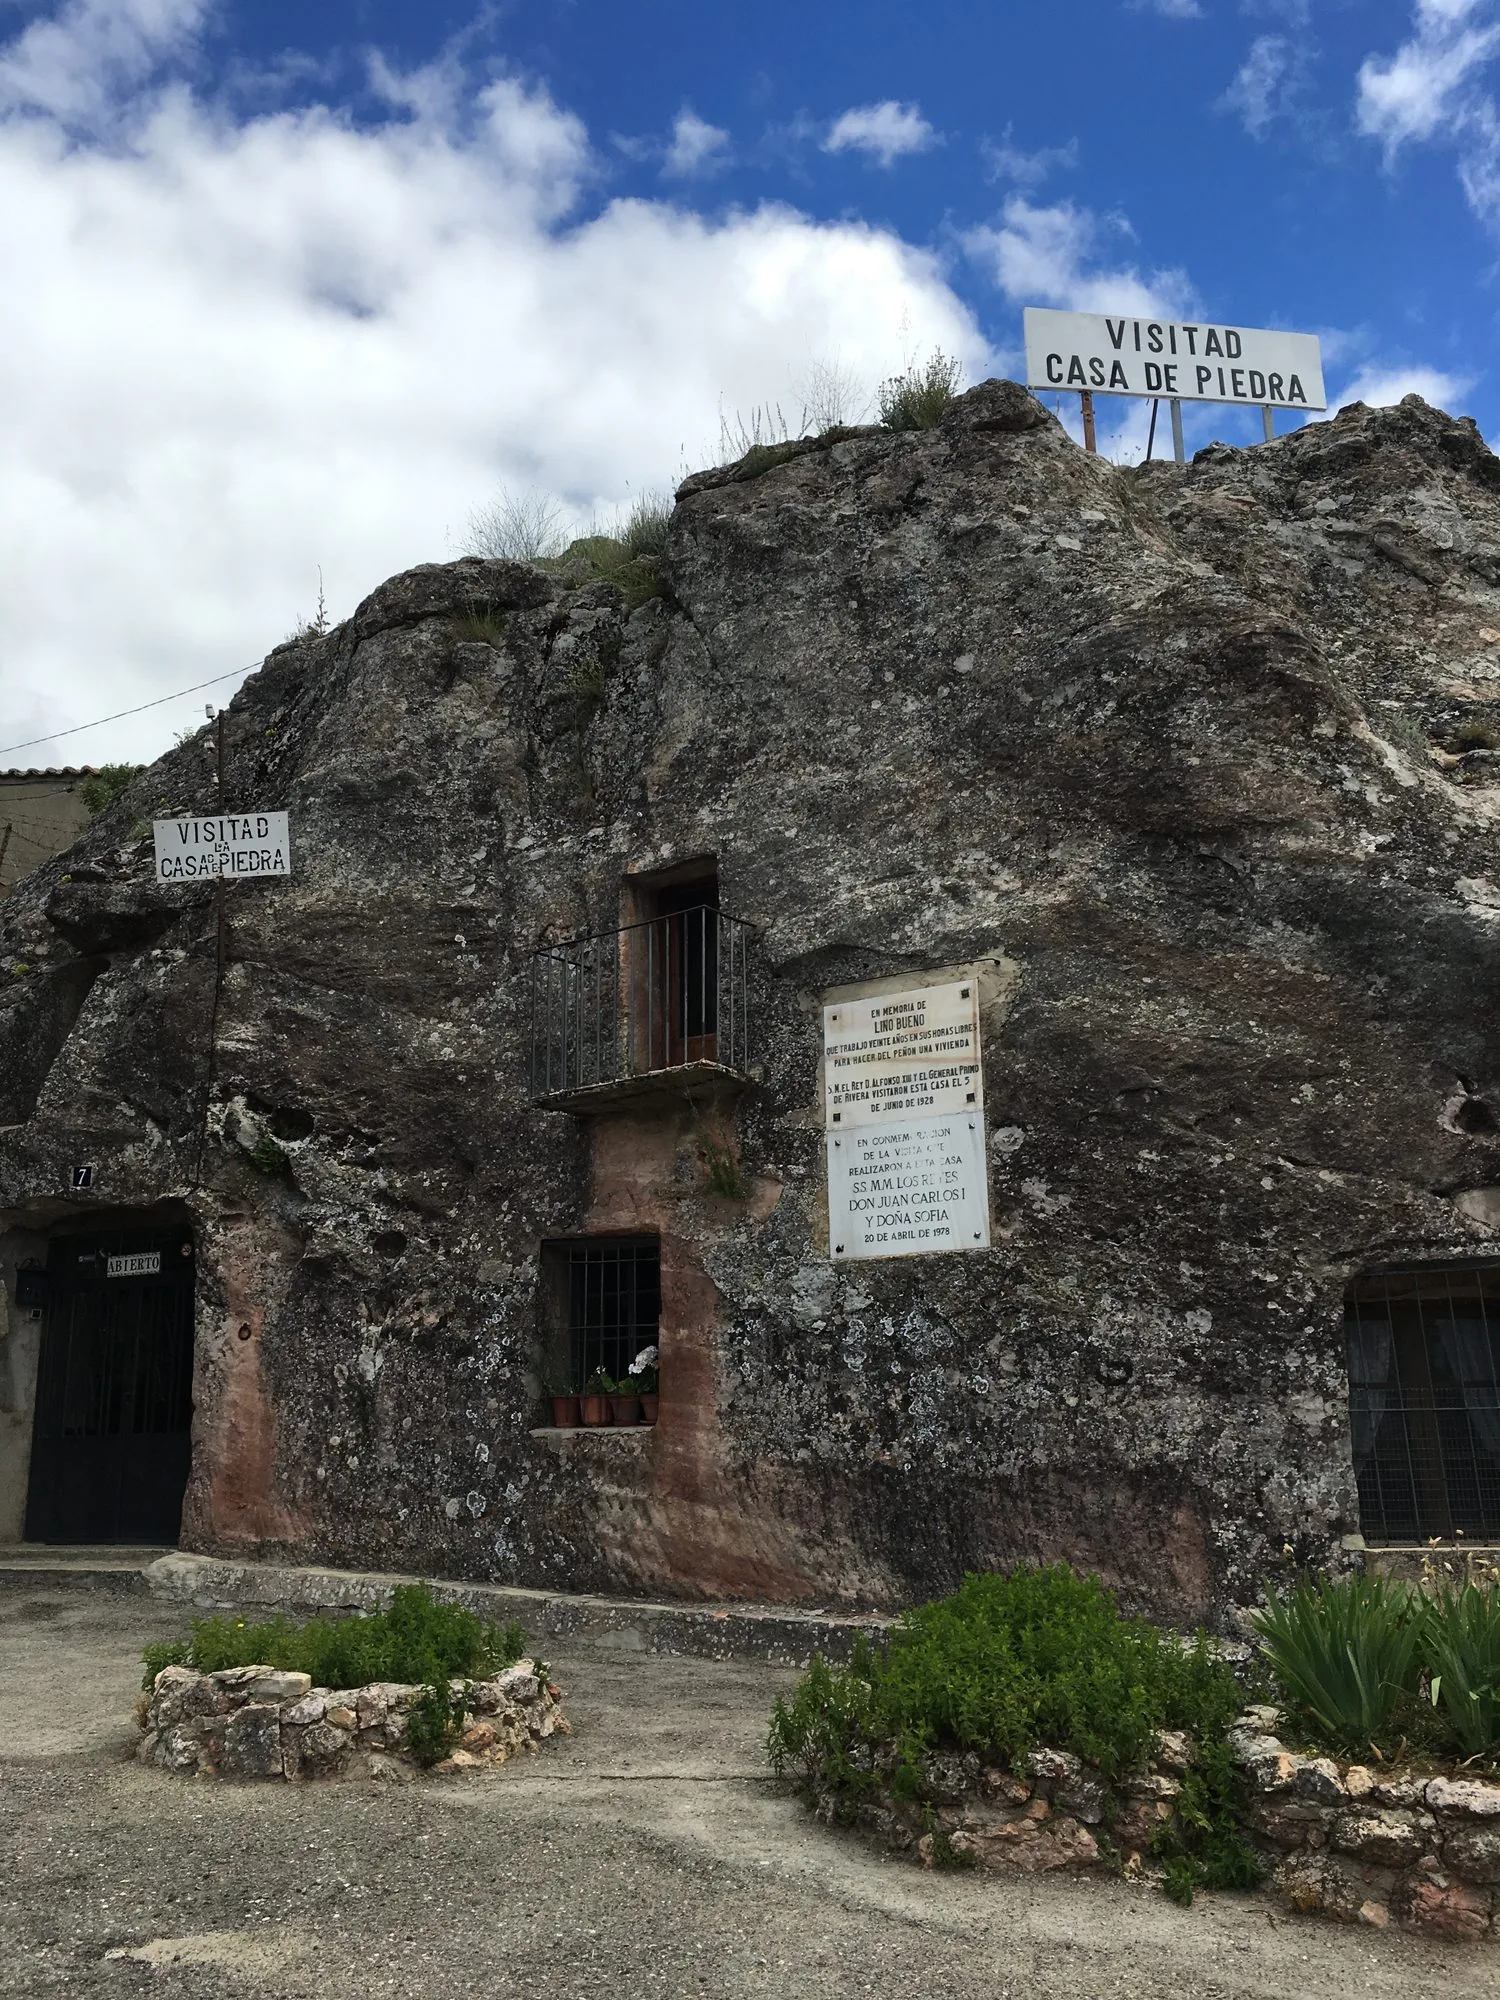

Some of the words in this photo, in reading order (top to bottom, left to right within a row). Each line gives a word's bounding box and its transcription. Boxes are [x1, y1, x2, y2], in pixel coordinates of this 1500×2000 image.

[1105, 319, 1242, 359] VISITAD
[1046, 353, 1129, 390] CASA
[1144, 362, 1178, 393] DE
[1196, 365, 1308, 403] PIEDRA
[177, 817, 268, 845] VISITAD
[214, 841, 230, 853] LA
[161, 855, 209, 877] CASA
[219, 849, 284, 872] PIEDRA
[871, 1008, 881, 1018] EN
[883, 1003, 914, 1016] MEMORIA
[917, 1000, 926, 1011] DE
[874, 1018, 894, 1034] LINO
[896, 1013, 925, 1030] BUENO
[826, 1045, 839, 1056] QUE
[840, 1041, 868, 1054] TRABAJO
[869, 1036, 891, 1049] VEINTE
[892, 1033, 908, 1045] AÑOS
[909, 1032, 919, 1042] EN
[919, 1030, 932, 1041] SUS
[932, 1026, 954, 1038] HORAS
[954, 1023, 978, 1035] LIBRES
[834, 1057, 851, 1068] PARA
[853, 1053, 876, 1065] HACER
[877, 1051, 891, 1061] DEL
[893, 1046, 917, 1059] PEÑON
[918, 1044, 933, 1054] UNA
[935, 1038, 970, 1052] VIVIENDA
[871, 1075, 901, 1088] ALFONSO
[912, 1073, 918, 1082] Y
[919, 1072, 928, 1081] EL
[928, 1067, 959, 1080] GENERAL
[958, 1064, 980, 1076] PRIMO
[833, 1095, 843, 1105] DE
[844, 1091, 870, 1103] RIVERA
[871, 1085, 909, 1099] VISITARON
[909, 1082, 928, 1094] ESTA
[930, 1079, 950, 1091] CASA
[951, 1077, 963, 1088] EL
[964, 1076, 970, 1085] 5
[870, 1103, 881, 1113] DE
[882, 1099, 904, 1112] JUNIO
[905, 1098, 916, 1108] DE
[917, 1096, 934, 1107] 1928
[857, 1138, 868, 1148] EN
[863, 1151, 875, 1161] DE
[878, 1150, 890, 1159] LA
[78, 1168, 87, 1185] 7
[848, 1162, 903, 1177] REALIZARON
[905, 1161, 912, 1170] A
[896, 1175, 919, 1189] LOS
[849, 1198, 875, 1212] DON
[877, 1194, 909, 1209] JUAN
[911, 1188, 960, 1205] CARLOS
[961, 1187, 966, 1200] I
[865, 1215, 874, 1228] Y
[876, 1210, 912, 1228] DOÑA
[914, 1209, 949, 1223] SOFIA
[864, 1234, 875, 1243] 20
[876, 1232, 889, 1242] DE
[891, 1230, 916, 1241] ABRIL
[918, 1228, 931, 1238] DE
[933, 1227, 950, 1237] 1978
[108, 1257, 159, 1273] ABIERTO
